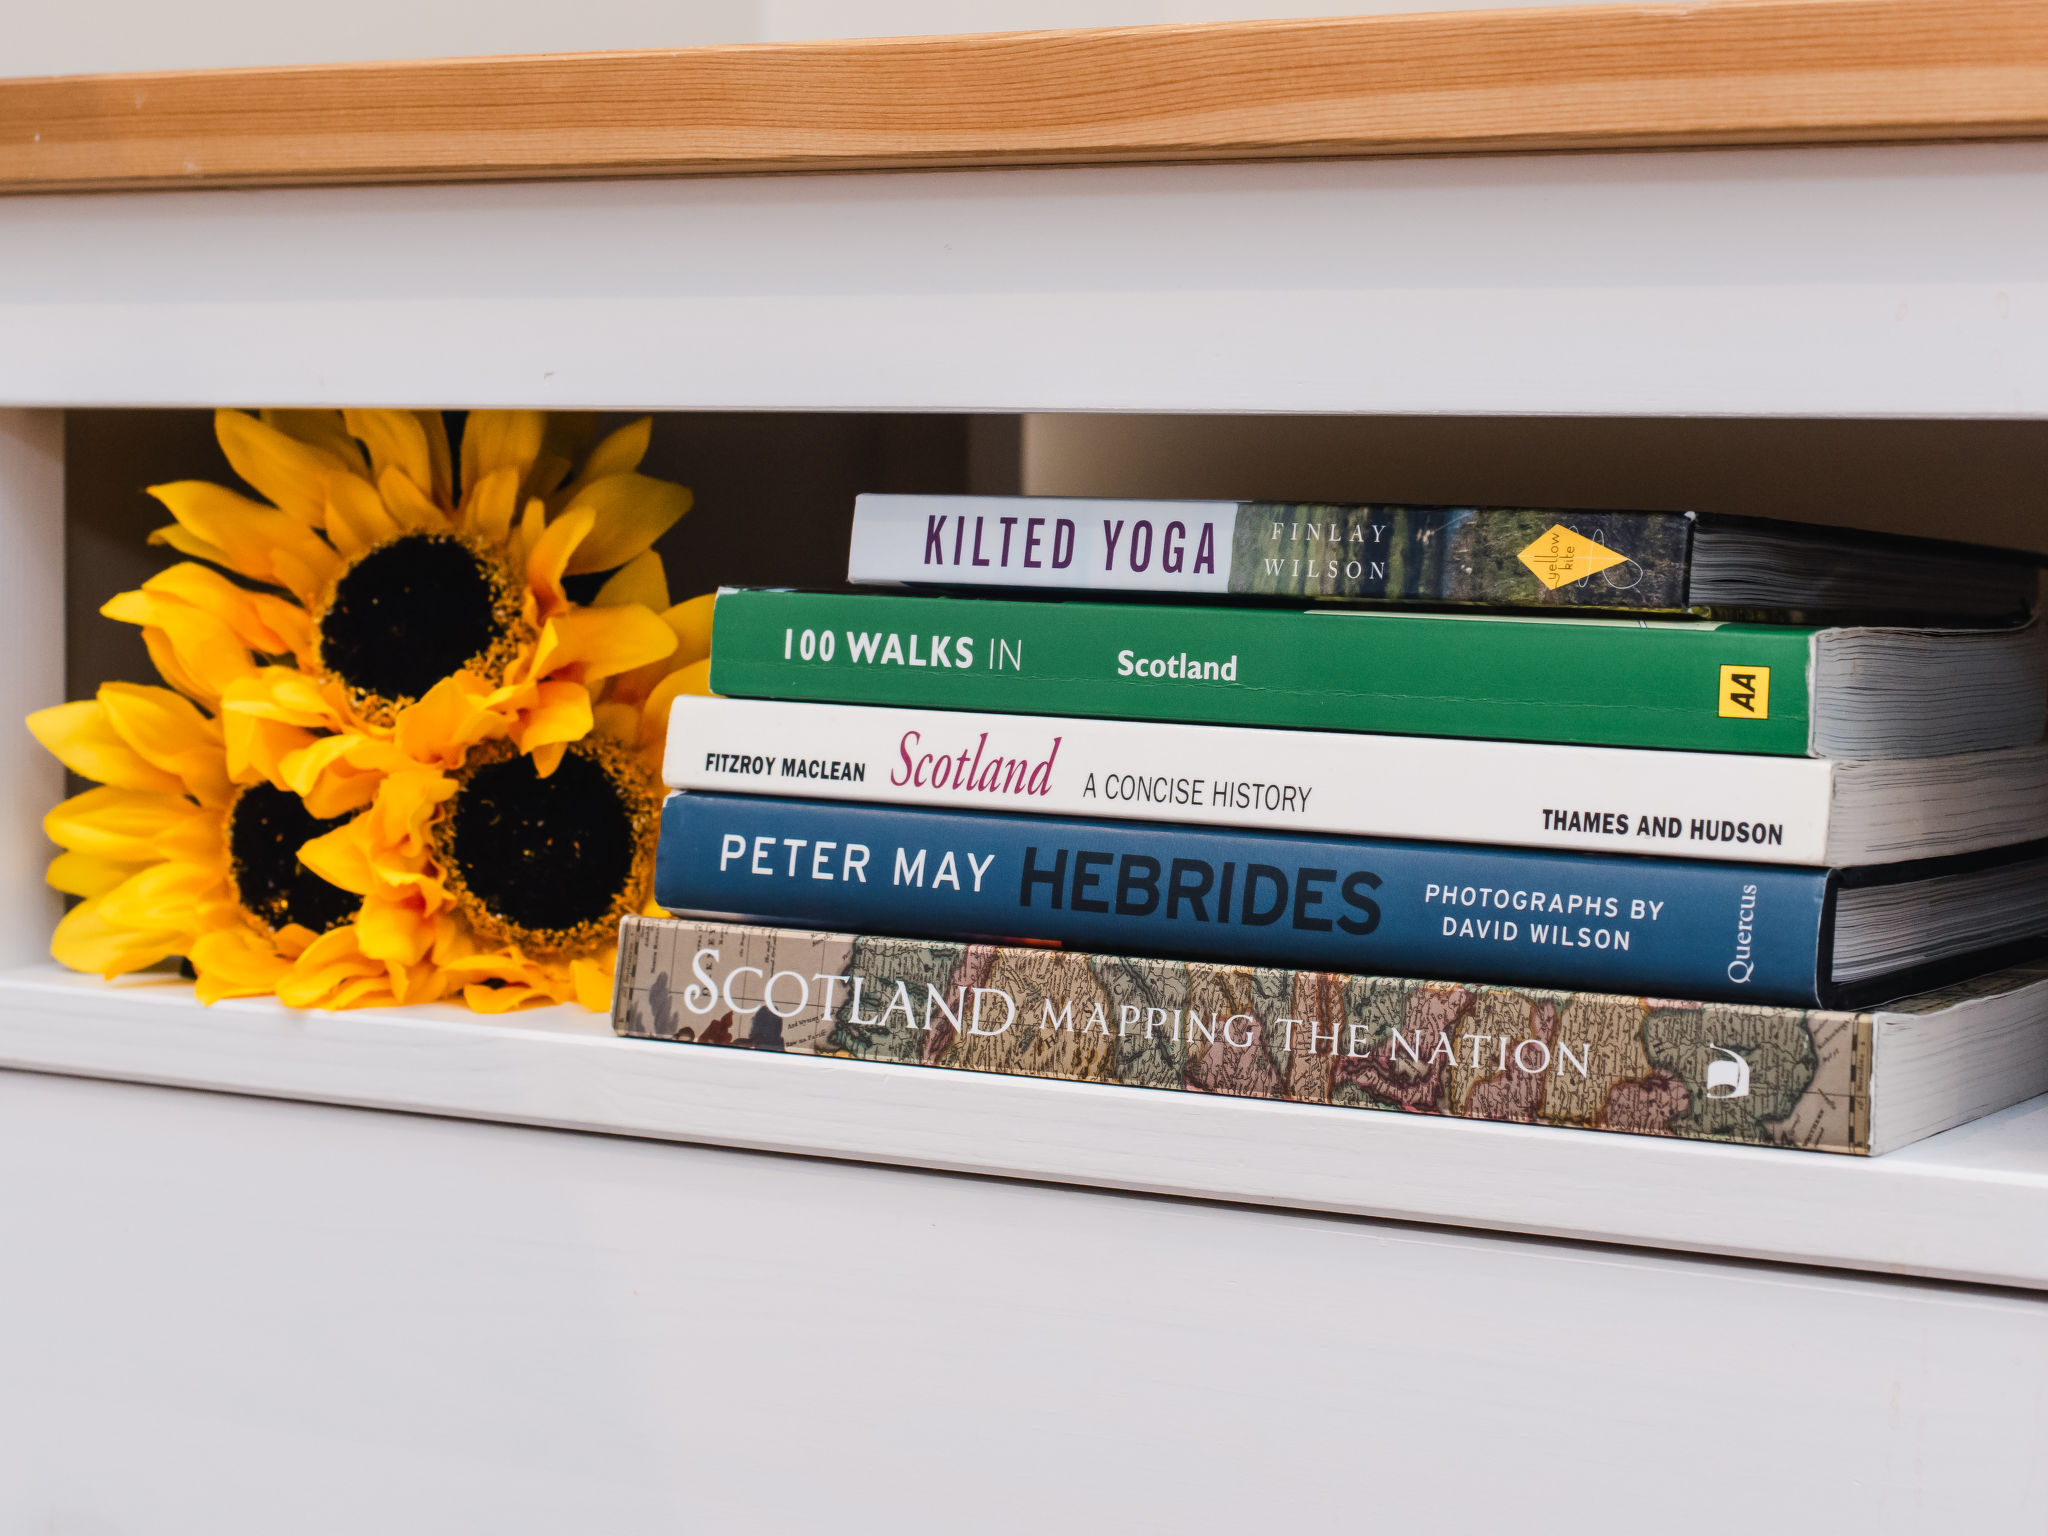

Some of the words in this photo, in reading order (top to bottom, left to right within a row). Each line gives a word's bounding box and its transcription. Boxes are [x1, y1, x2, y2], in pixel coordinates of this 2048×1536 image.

[923, 514, 1077, 569] KILTED
[1103, 518, 1216, 575] YOGA
[1271, 521, 1388, 544] FINLAY
[1263, 558, 1388, 581] WILSON
[1532, 532, 1560, 588] yellow
[1559, 545, 1576, 570] kite
[784, 627, 836, 663] 100
[846, 630, 975, 669] WALKS
[988, 637, 1023, 672] IN
[1117, 649, 1238, 682] Scotland
[1729, 672, 1757, 713] AA
[704, 752, 777, 777] FITZROY
[781, 756, 867, 783] MACLEAN
[890, 730, 1063, 796] Scotland
[1082, 772, 1099, 799] A
[1103, 773, 1205, 806] CONCISE
[1211, 779, 1314, 814] HISTORY
[1542, 808, 1630, 836] THAMES
[1636, 814, 1683, 840] AND
[1689, 818, 1784, 846] HUDSON
[718, 833, 872, 884] PETER
[892, 846, 996, 893] MAY
[1018, 845, 1385, 936] HEBRIDES
[1425, 883, 1619, 919] PHOTOGRAPHS
[1630, 898, 1665, 922] BY
[1442, 915, 1518, 943] DAVID
[1529, 922, 1631, 952] WILSON
[1726, 883, 1758, 985] Quercus
[683, 947, 1016, 1037] SCOTLAND
[1039, 998, 1257, 1048] MAPPING
[1273, 1017, 1371, 1060] THE
[1390, 1025, 1591, 1079] NATION
